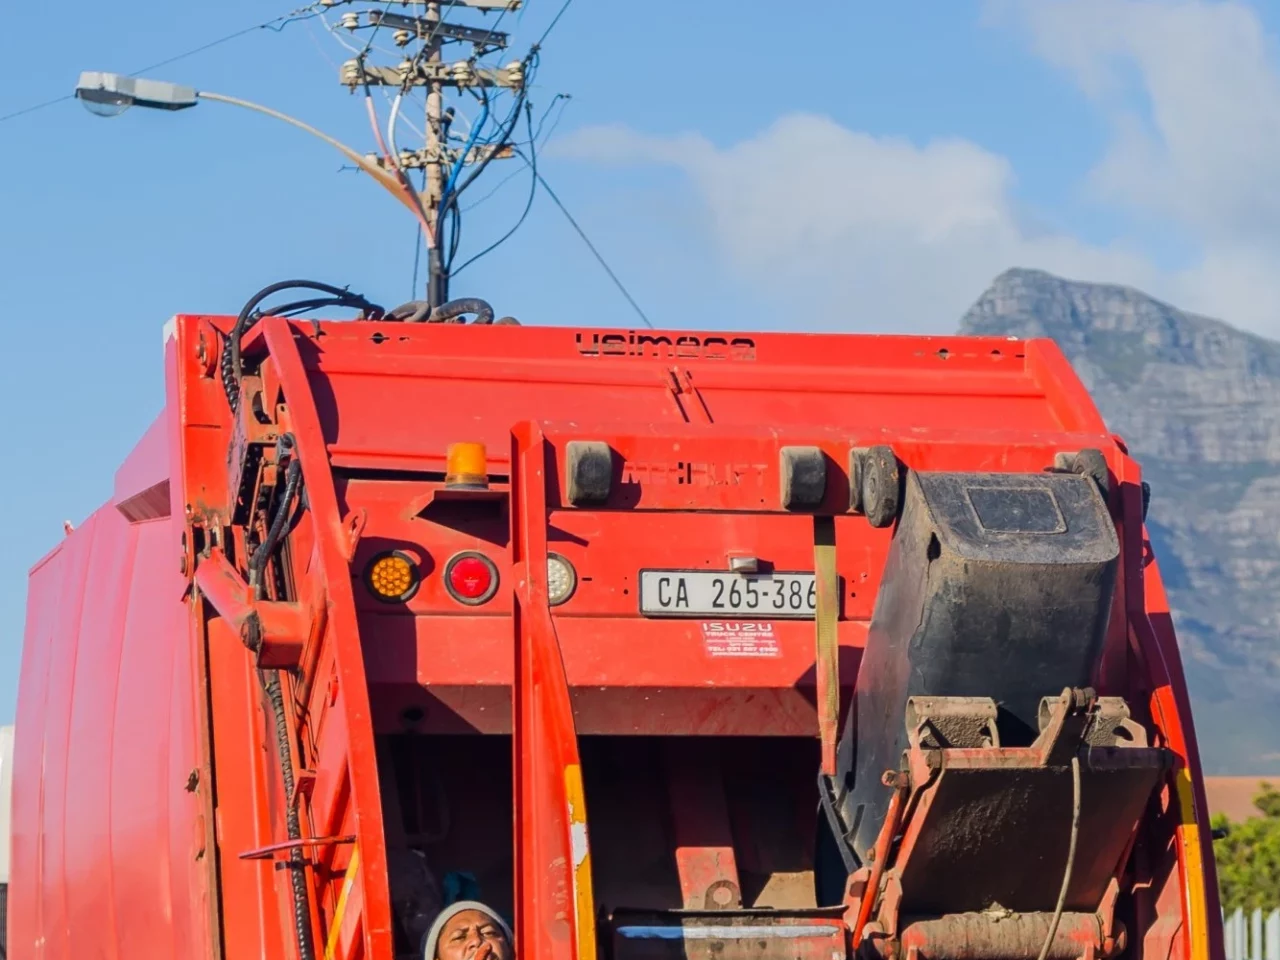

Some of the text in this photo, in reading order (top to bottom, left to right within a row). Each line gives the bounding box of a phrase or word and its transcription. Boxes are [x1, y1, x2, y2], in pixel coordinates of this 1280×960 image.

[658, 577, 816, 610] CA 265-386
[702, 622, 773, 632] ISUZU
